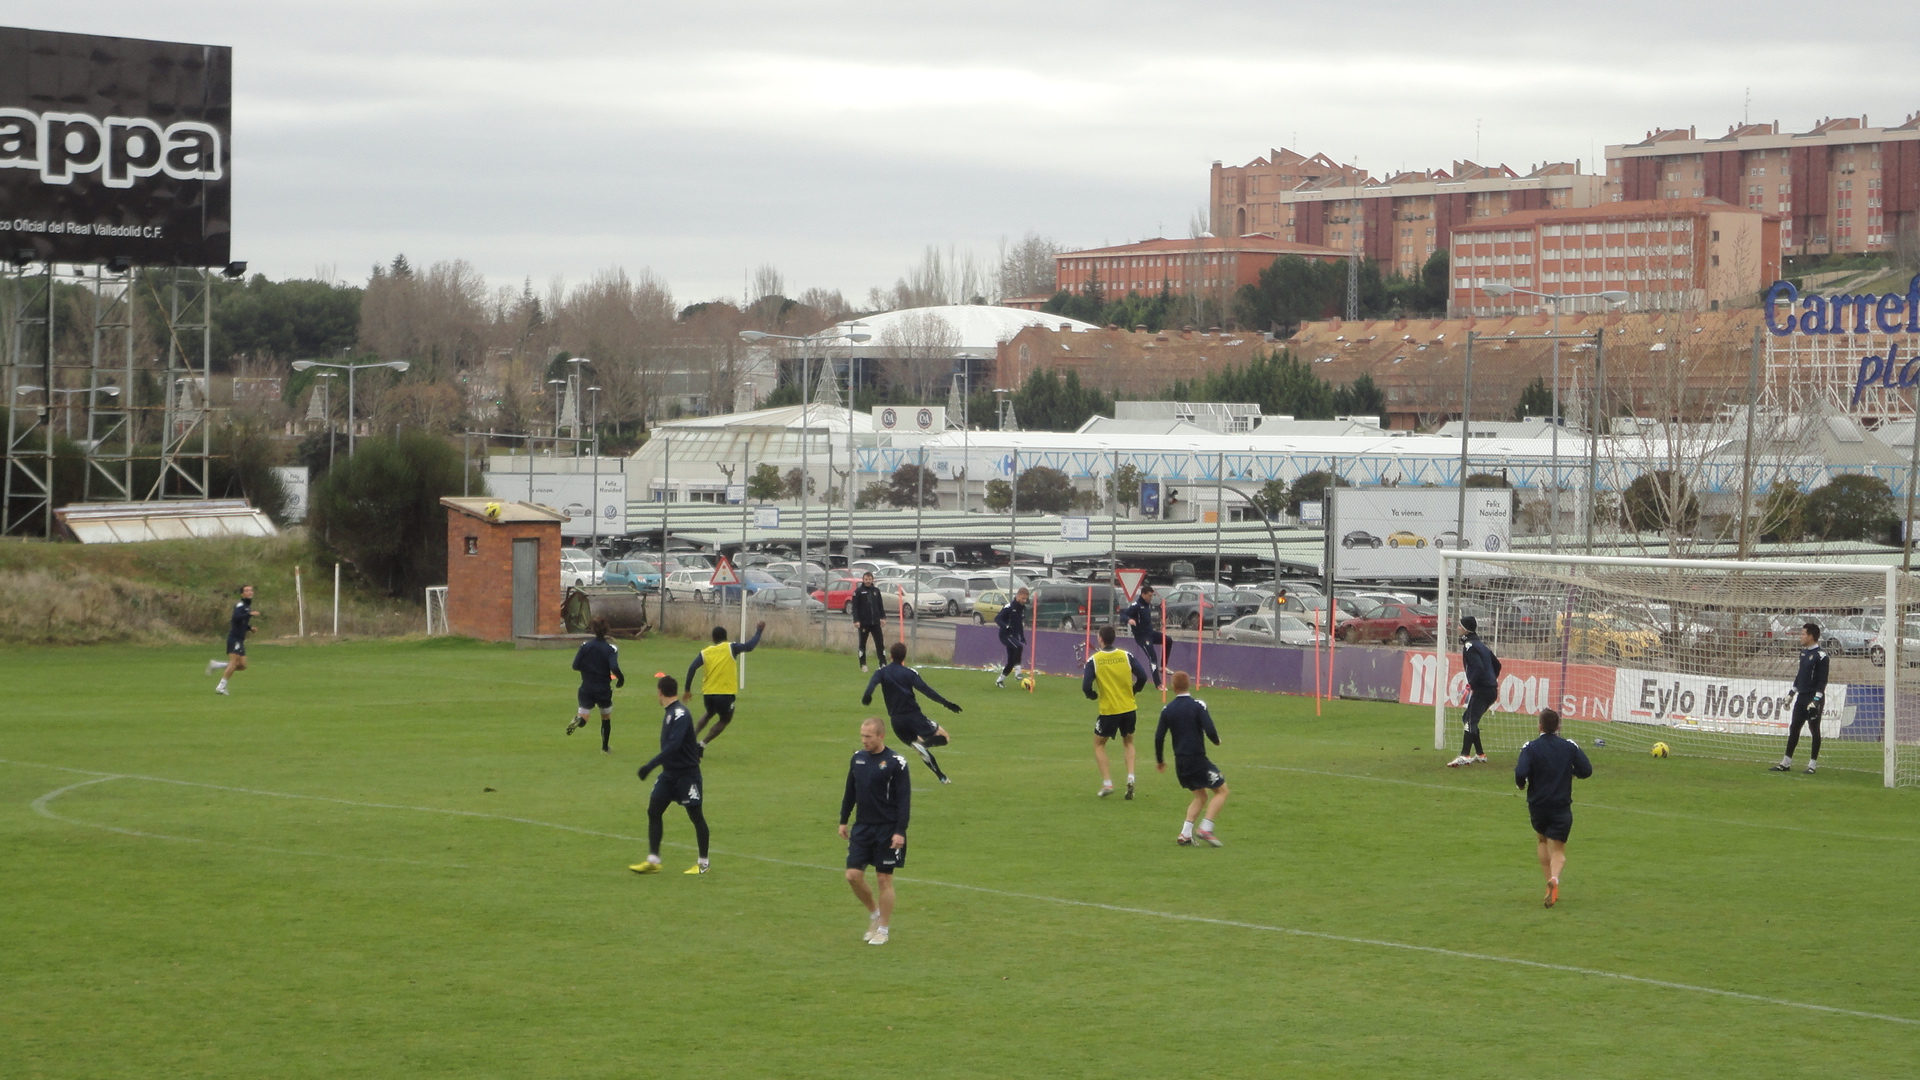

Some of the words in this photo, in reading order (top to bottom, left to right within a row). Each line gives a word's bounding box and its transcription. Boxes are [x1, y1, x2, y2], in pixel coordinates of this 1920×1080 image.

[13, 218, 47, 233] Oficial
[48, 221, 65, 234] del
[67, 222, 91, 235] Real
[93, 223, 142, 238] Valladolid
[143, 225, 163, 239] C.F.
[1486, 500, 1501, 508] Feliz
[1391, 508, 1400, 517] Ya
[1401, 508, 1424, 517] vienen.
[1479, 509, 1507, 517] Navidad
[1409, 653, 1550, 716] Maou
[1562, 694, 1611, 720] SIN
[1639, 678, 1696, 720] Eylo
